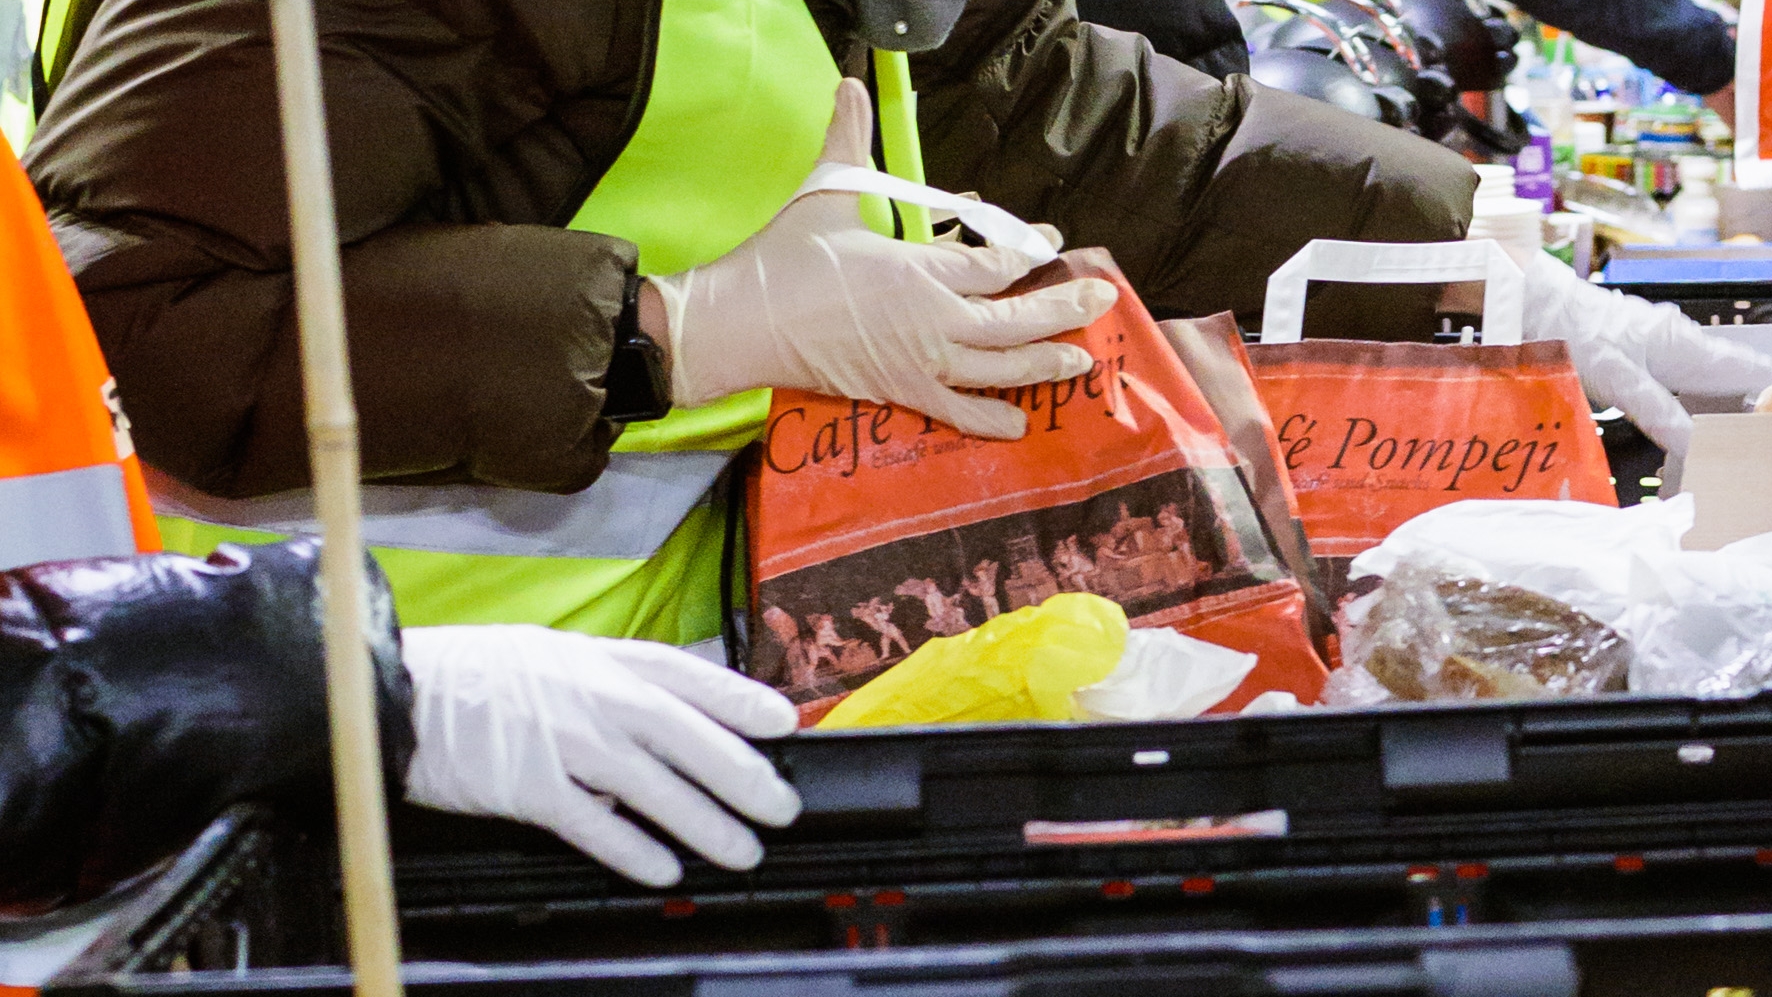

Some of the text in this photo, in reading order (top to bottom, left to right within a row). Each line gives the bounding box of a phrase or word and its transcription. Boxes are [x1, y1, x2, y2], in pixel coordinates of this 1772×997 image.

[918, 333, 1127, 435] mpeji
[1278, 413, 1562, 493] fé Pompeji
